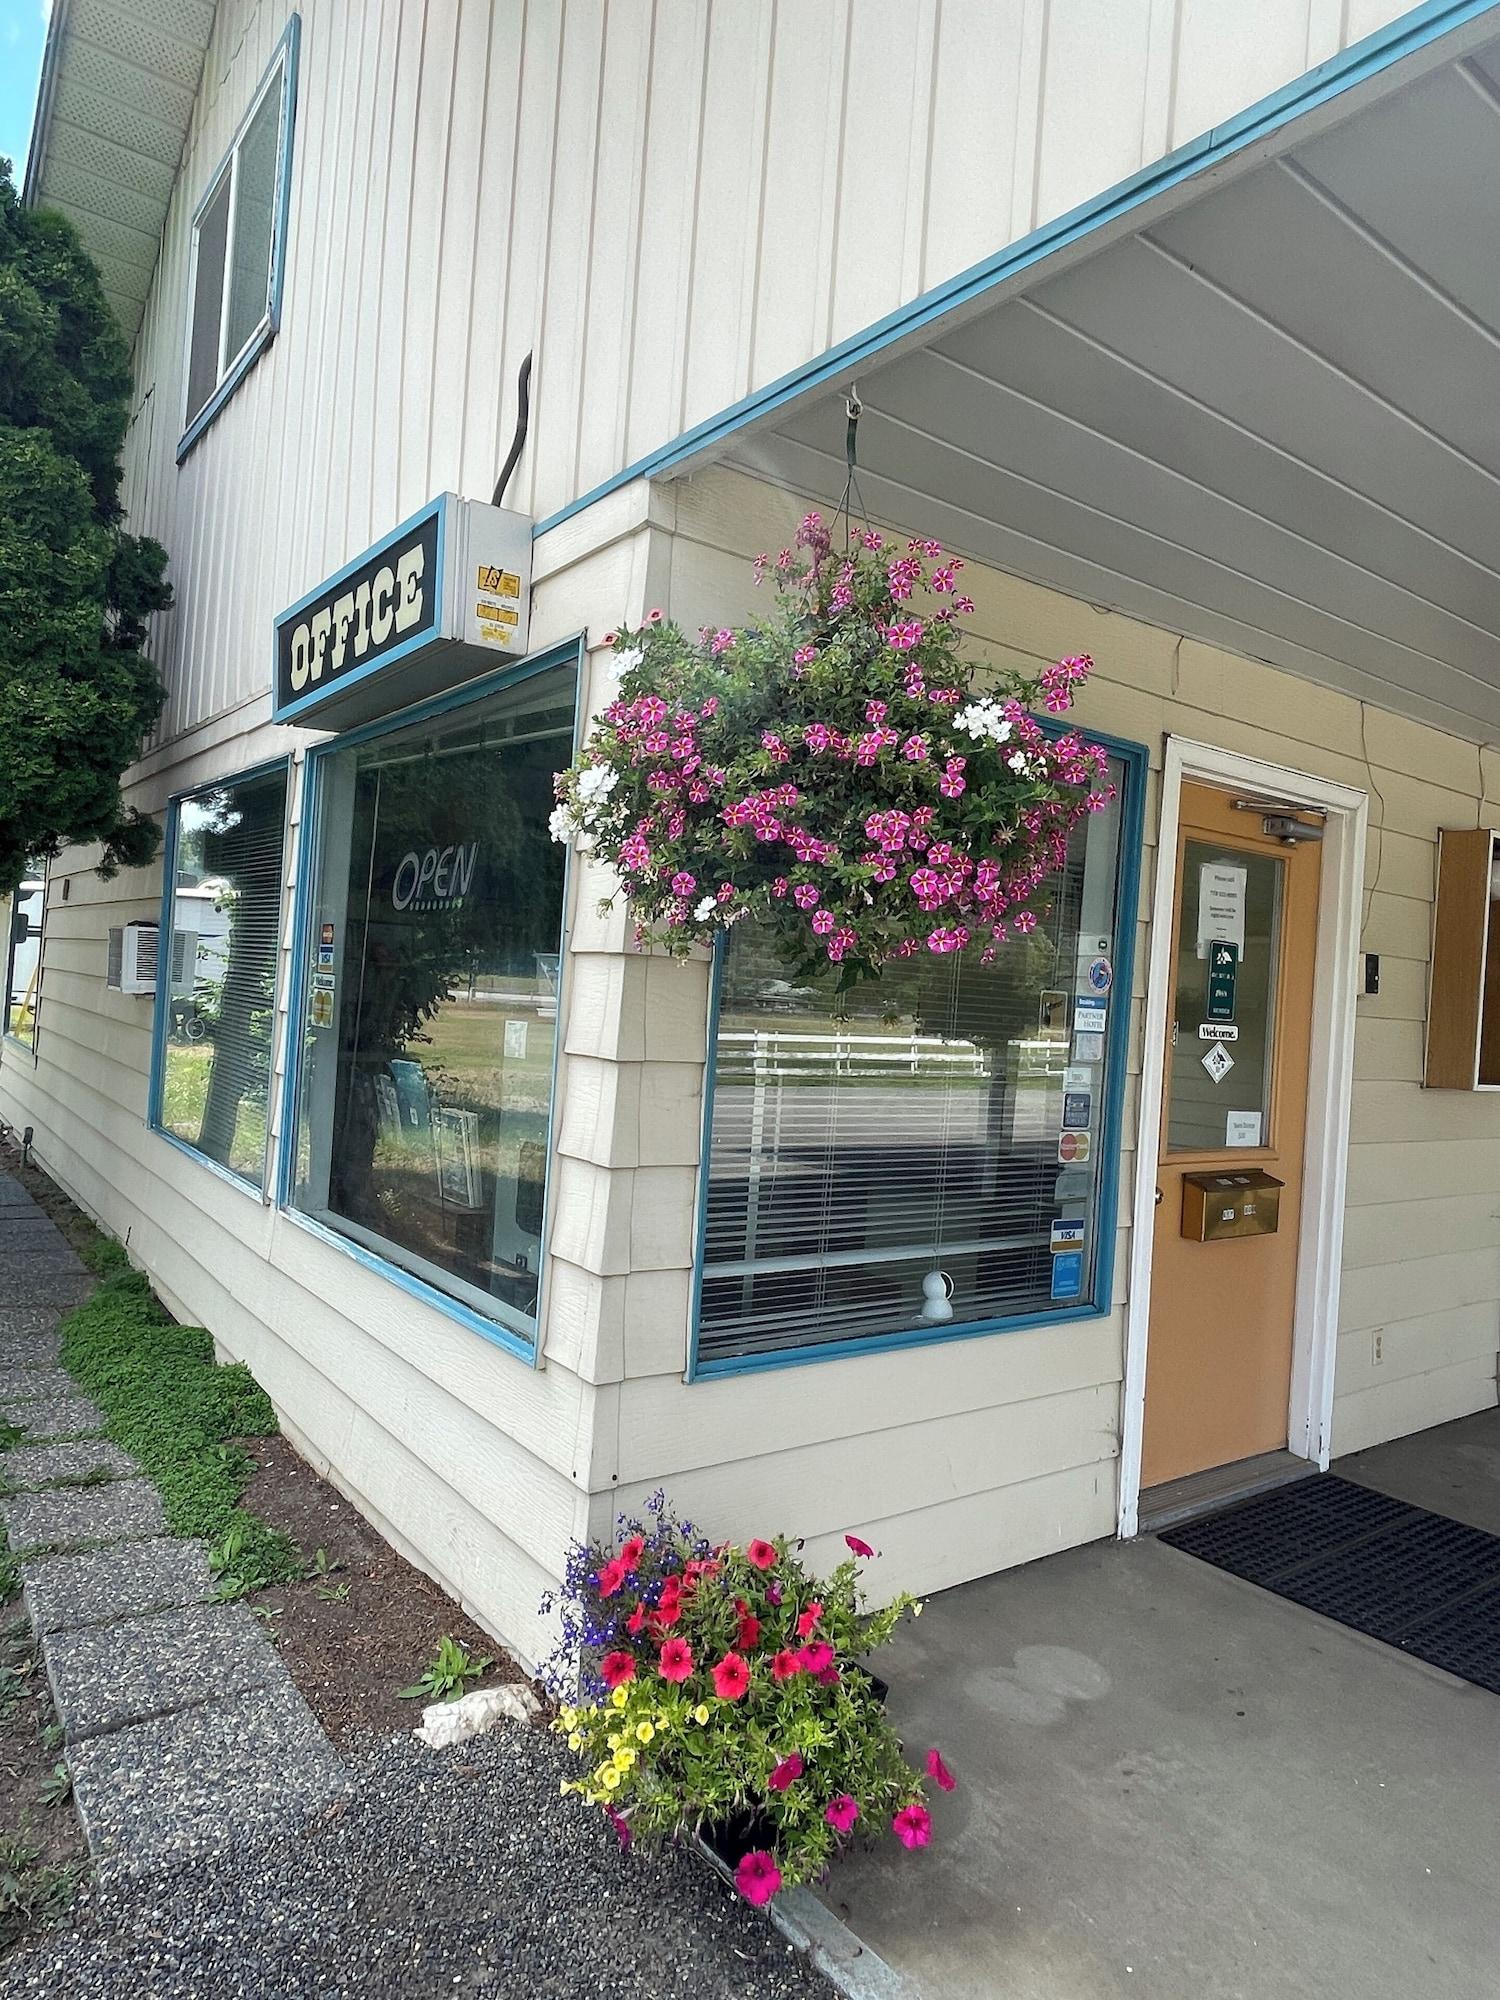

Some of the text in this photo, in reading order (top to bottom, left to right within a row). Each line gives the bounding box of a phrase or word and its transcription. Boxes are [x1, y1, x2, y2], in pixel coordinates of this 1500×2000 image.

[291, 544, 424, 691] OFFICE
[392, 841, 478, 911] OPEN
[1078, 1011, 1104, 1020] PARTNER
[1083, 1020, 1103, 1029] HOTEL
[1060, 1230, 1076, 1240] VISA
